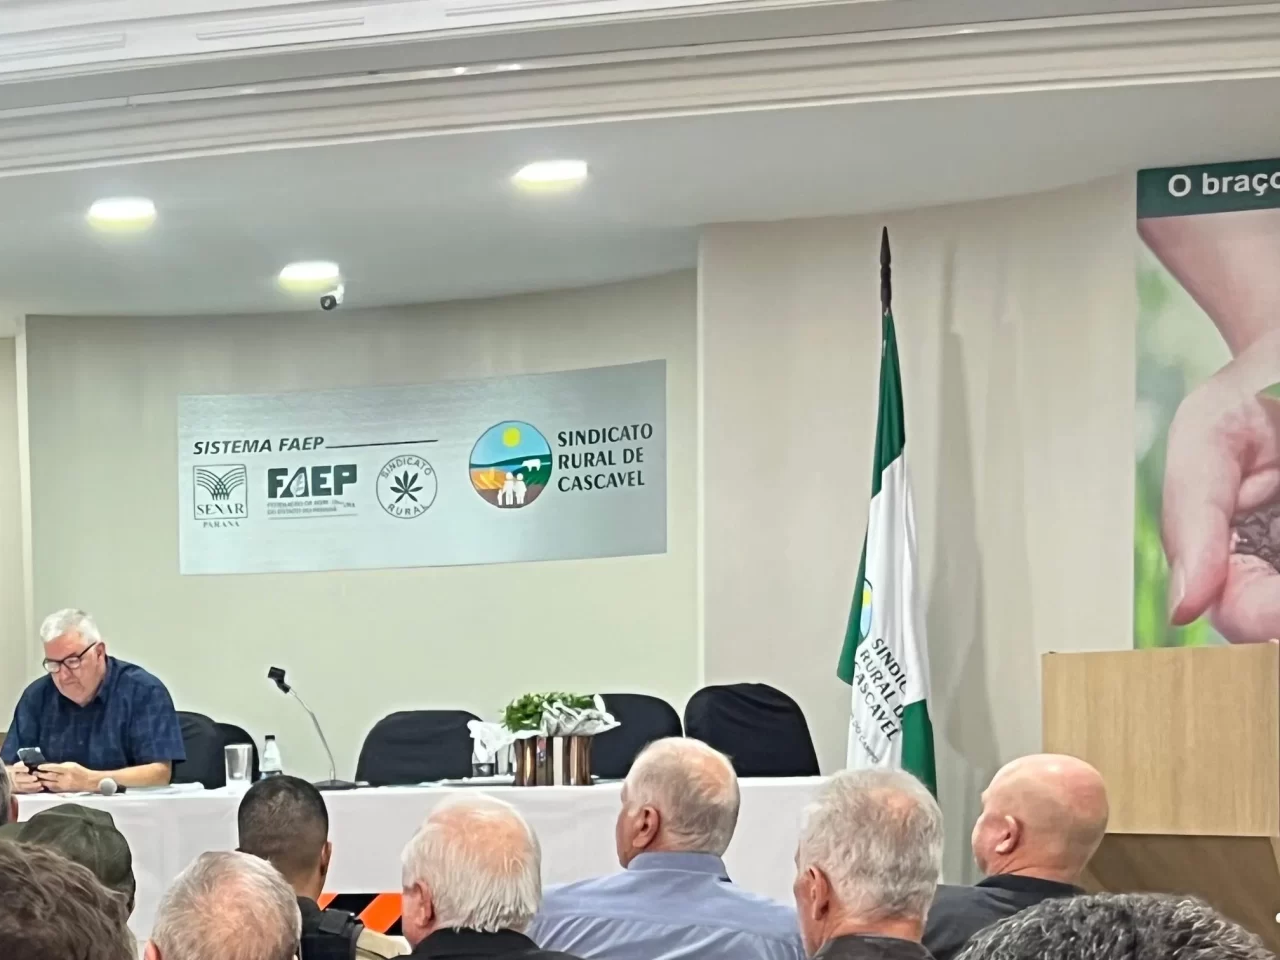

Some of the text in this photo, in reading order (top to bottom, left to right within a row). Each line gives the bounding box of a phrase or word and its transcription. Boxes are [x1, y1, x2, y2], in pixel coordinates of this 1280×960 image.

[1168, 172, 1280, 197] O braço
[193, 436, 324, 455] SISTEMA FAEP
[558, 423, 653, 447] SINDICATO
[380, 457, 432, 479] SINDICATO
[558, 447, 644, 469] RURAL DE
[268, 464, 357, 498] FAEP
[558, 470, 645, 492] CASCAVEL
[387, 502, 429, 516] RURAL
[860, 649, 896, 704] RURAL
